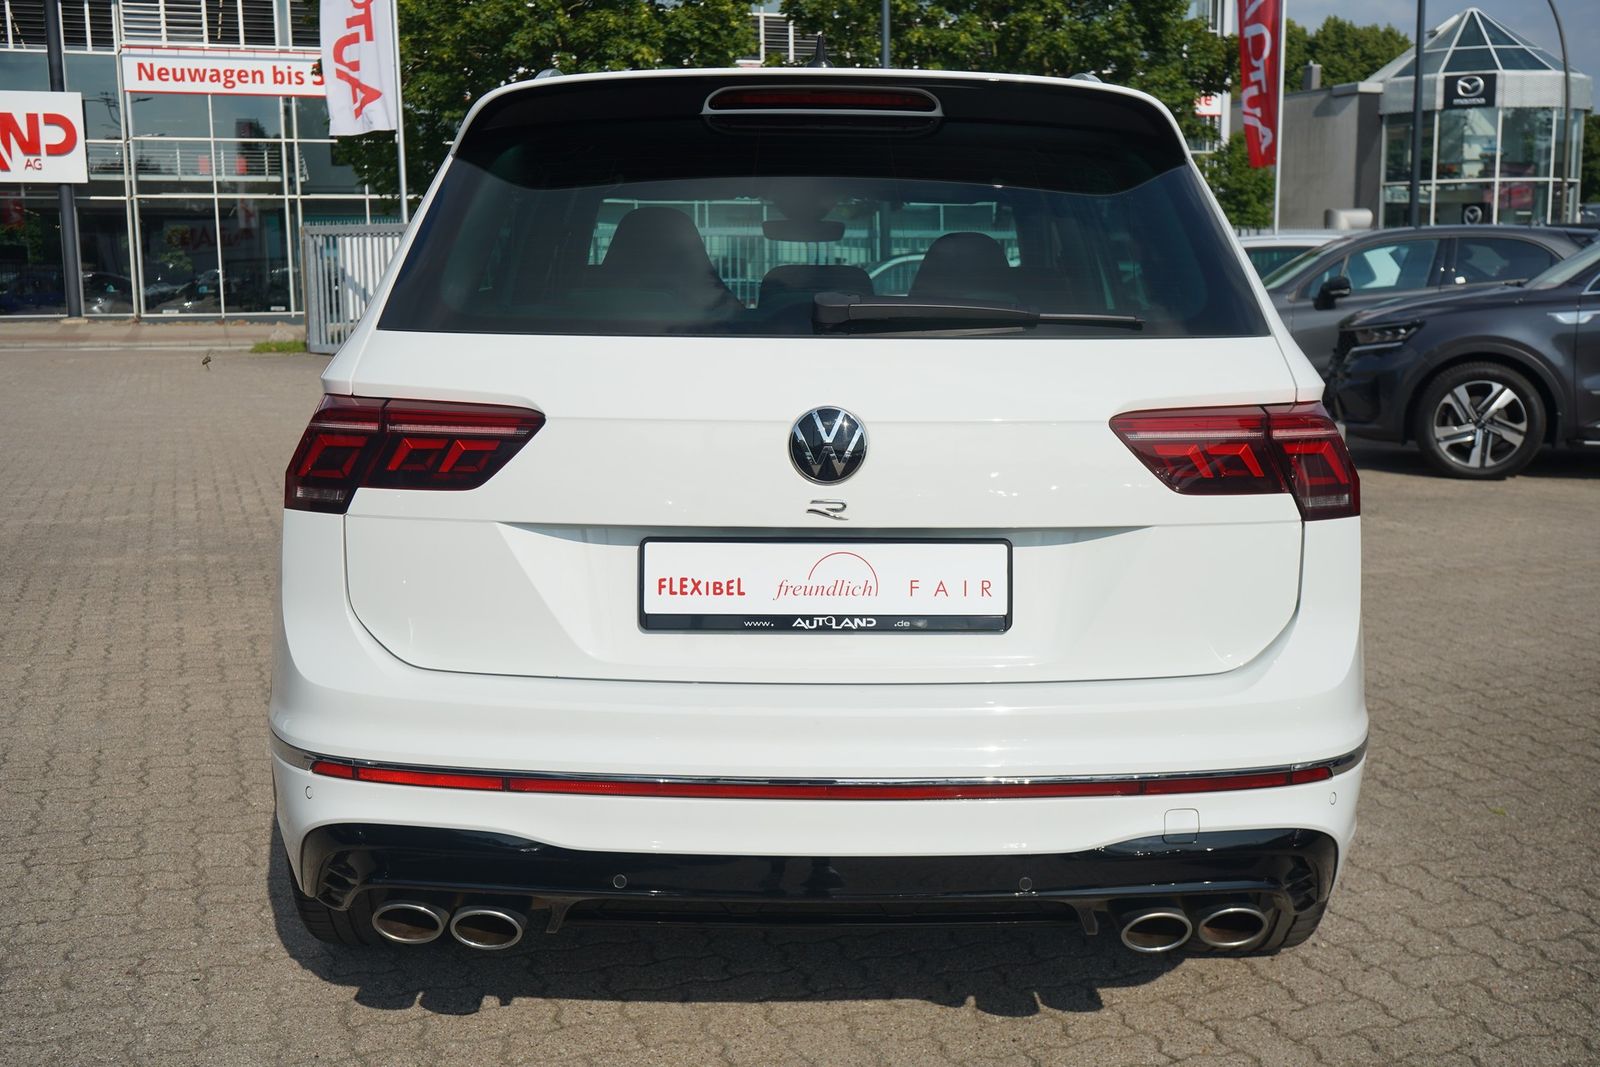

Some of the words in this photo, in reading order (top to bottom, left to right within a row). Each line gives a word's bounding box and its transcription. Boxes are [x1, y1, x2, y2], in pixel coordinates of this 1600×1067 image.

[137, 62, 265, 89] Neuwagen
[272, 65, 305, 85] bis
[25, 158, 43, 171] AG
[806, 499, 849, 521] R
[658, 577, 746, 597] FLEXIBEL
[773, 579, 874, 601] freundlich
[909, 579, 993, 597] FAIR
[743, 620, 775, 628] www.
[792, 615, 877, 630] AUTOLAND
[894, 619, 911, 628] .de
